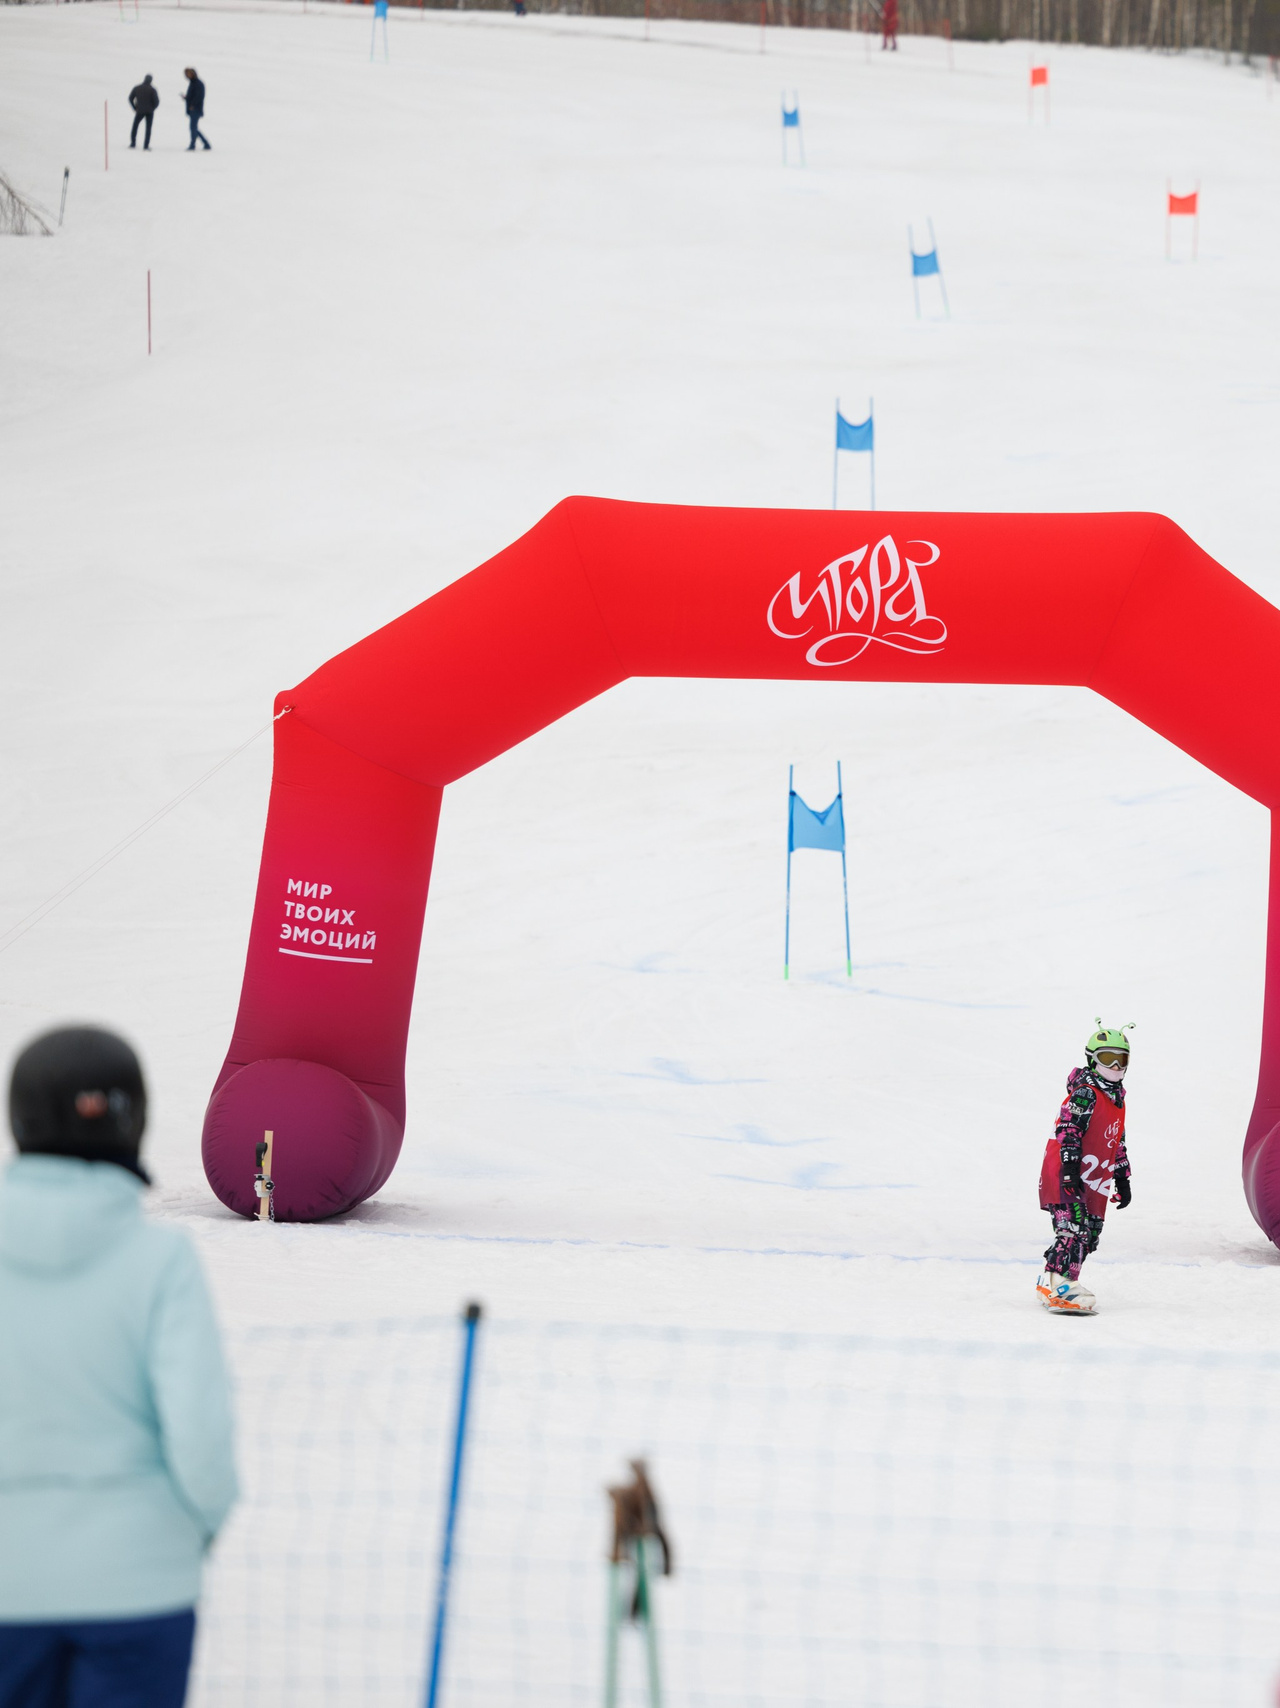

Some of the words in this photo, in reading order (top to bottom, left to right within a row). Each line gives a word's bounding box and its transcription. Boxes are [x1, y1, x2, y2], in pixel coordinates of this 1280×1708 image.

[287, 878, 333, 899] МИР
[284, 900, 356, 926] ТВОИХ
[280, 923, 377, 950] ЭМОЦИЙ
